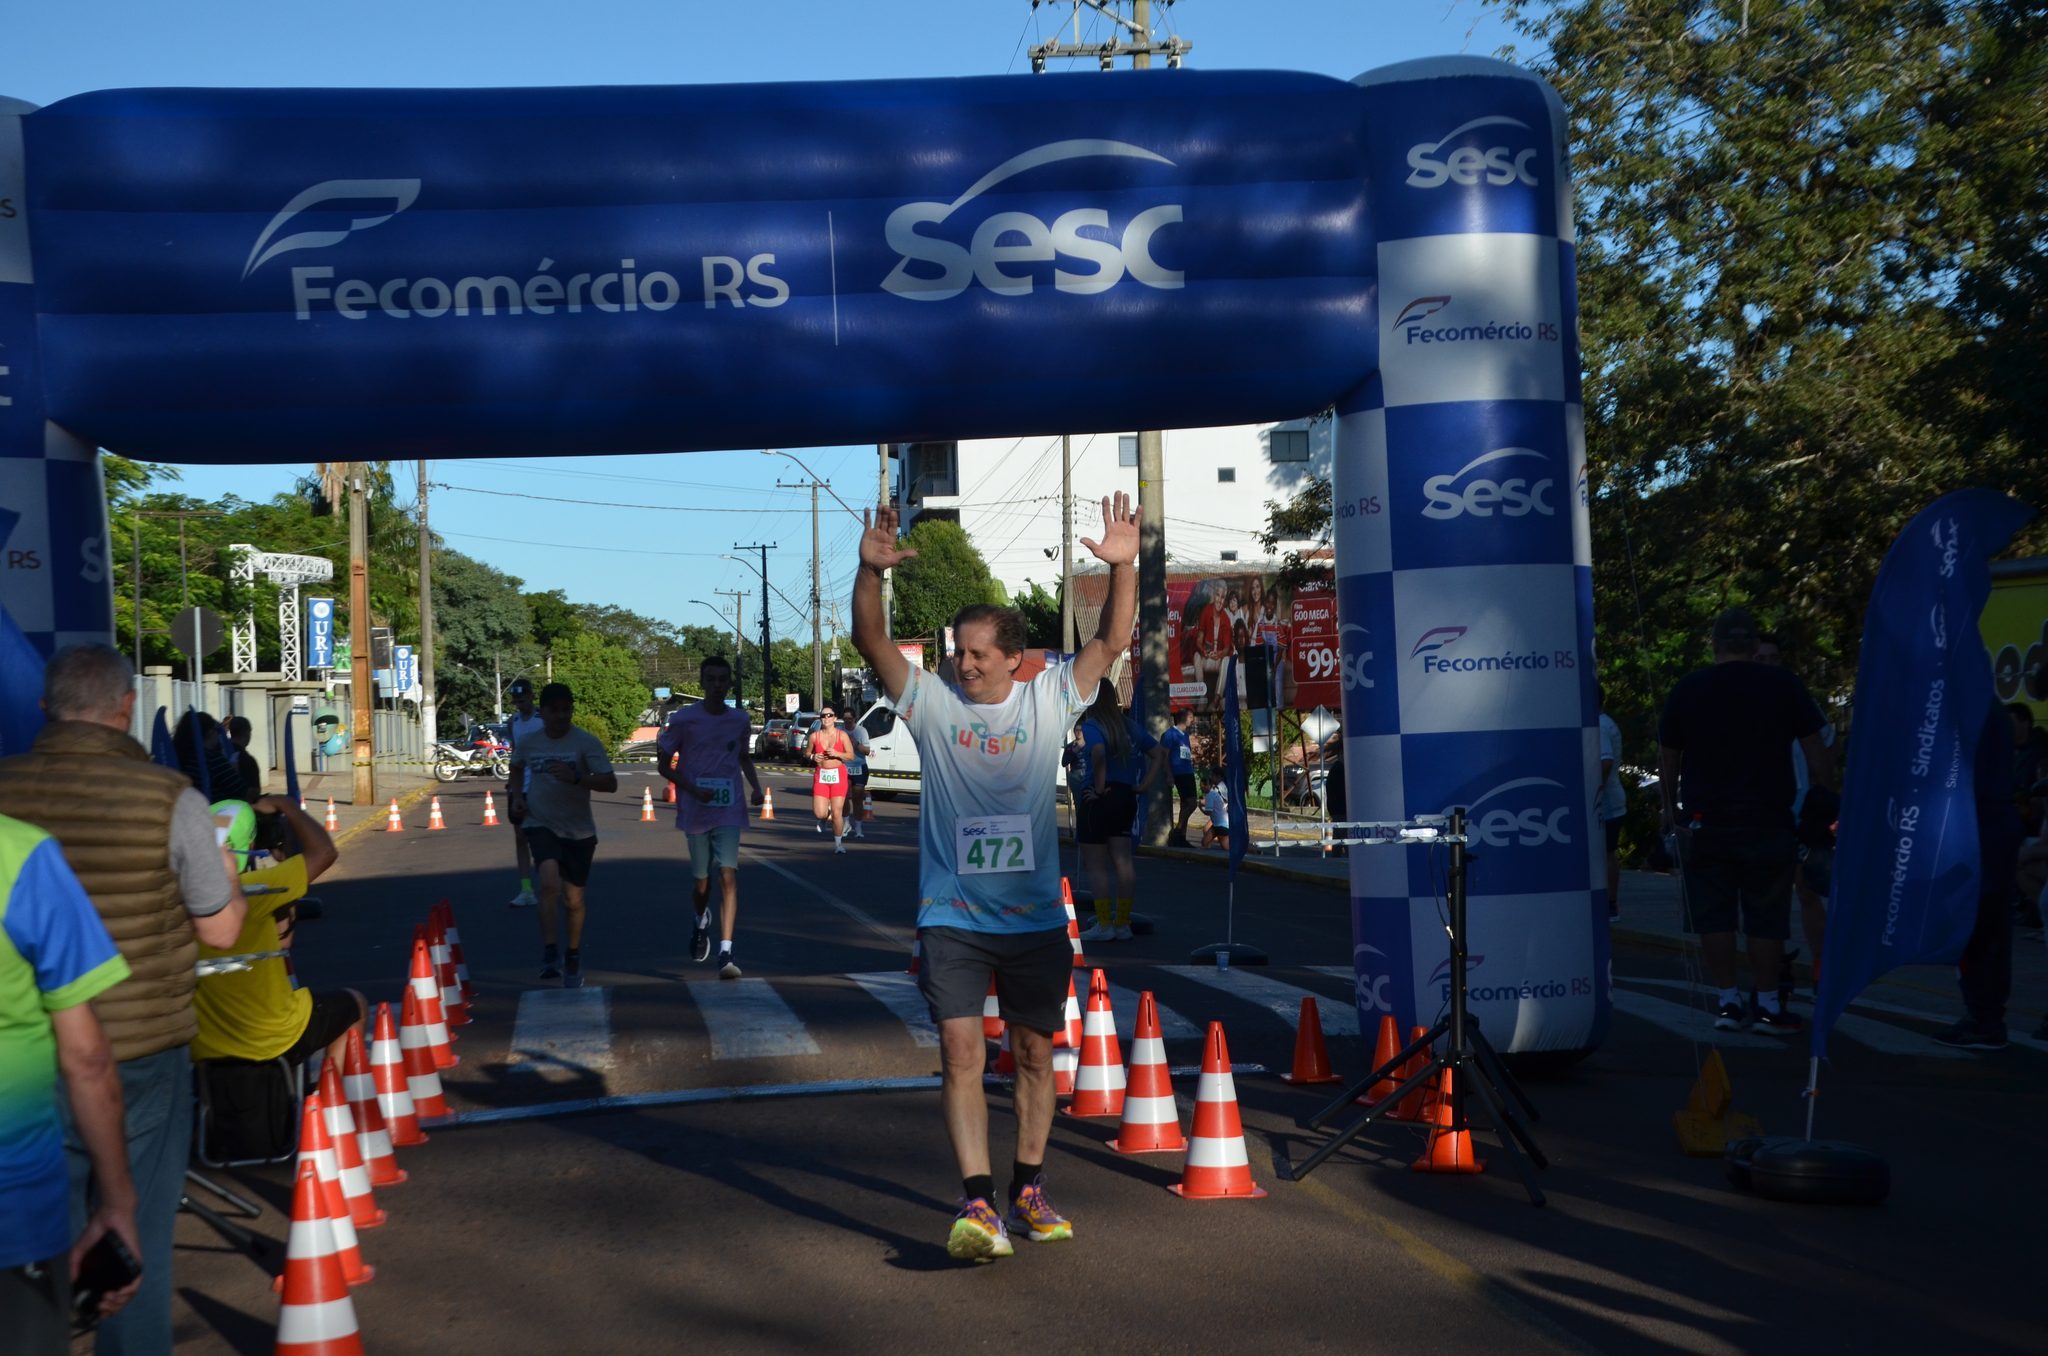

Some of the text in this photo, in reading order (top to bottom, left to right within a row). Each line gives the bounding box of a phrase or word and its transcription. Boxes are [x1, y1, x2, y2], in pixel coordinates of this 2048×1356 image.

[291, 252, 790, 321] Fecomércio RS
[1407, 321, 1559, 345] Fecomércio RS
[1359, 495, 1382, 516] RS
[8, 550, 41, 570] RS
[1294, 608, 1330, 621] 600 MEGA
[314, 620, 329, 665] URI
[1424, 650, 1575, 674] Fecomércio RS
[398, 660, 409, 690] URI
[821, 774, 837, 782] 406
[1881, 837, 1915, 947] Fecomércio
[1899, 804, 1921, 833] RS
[1911, 678, 1946, 778] Sindicatos
[967, 836, 1025, 869] 472
[1441, 977, 1592, 1002] Fcomércio RS
